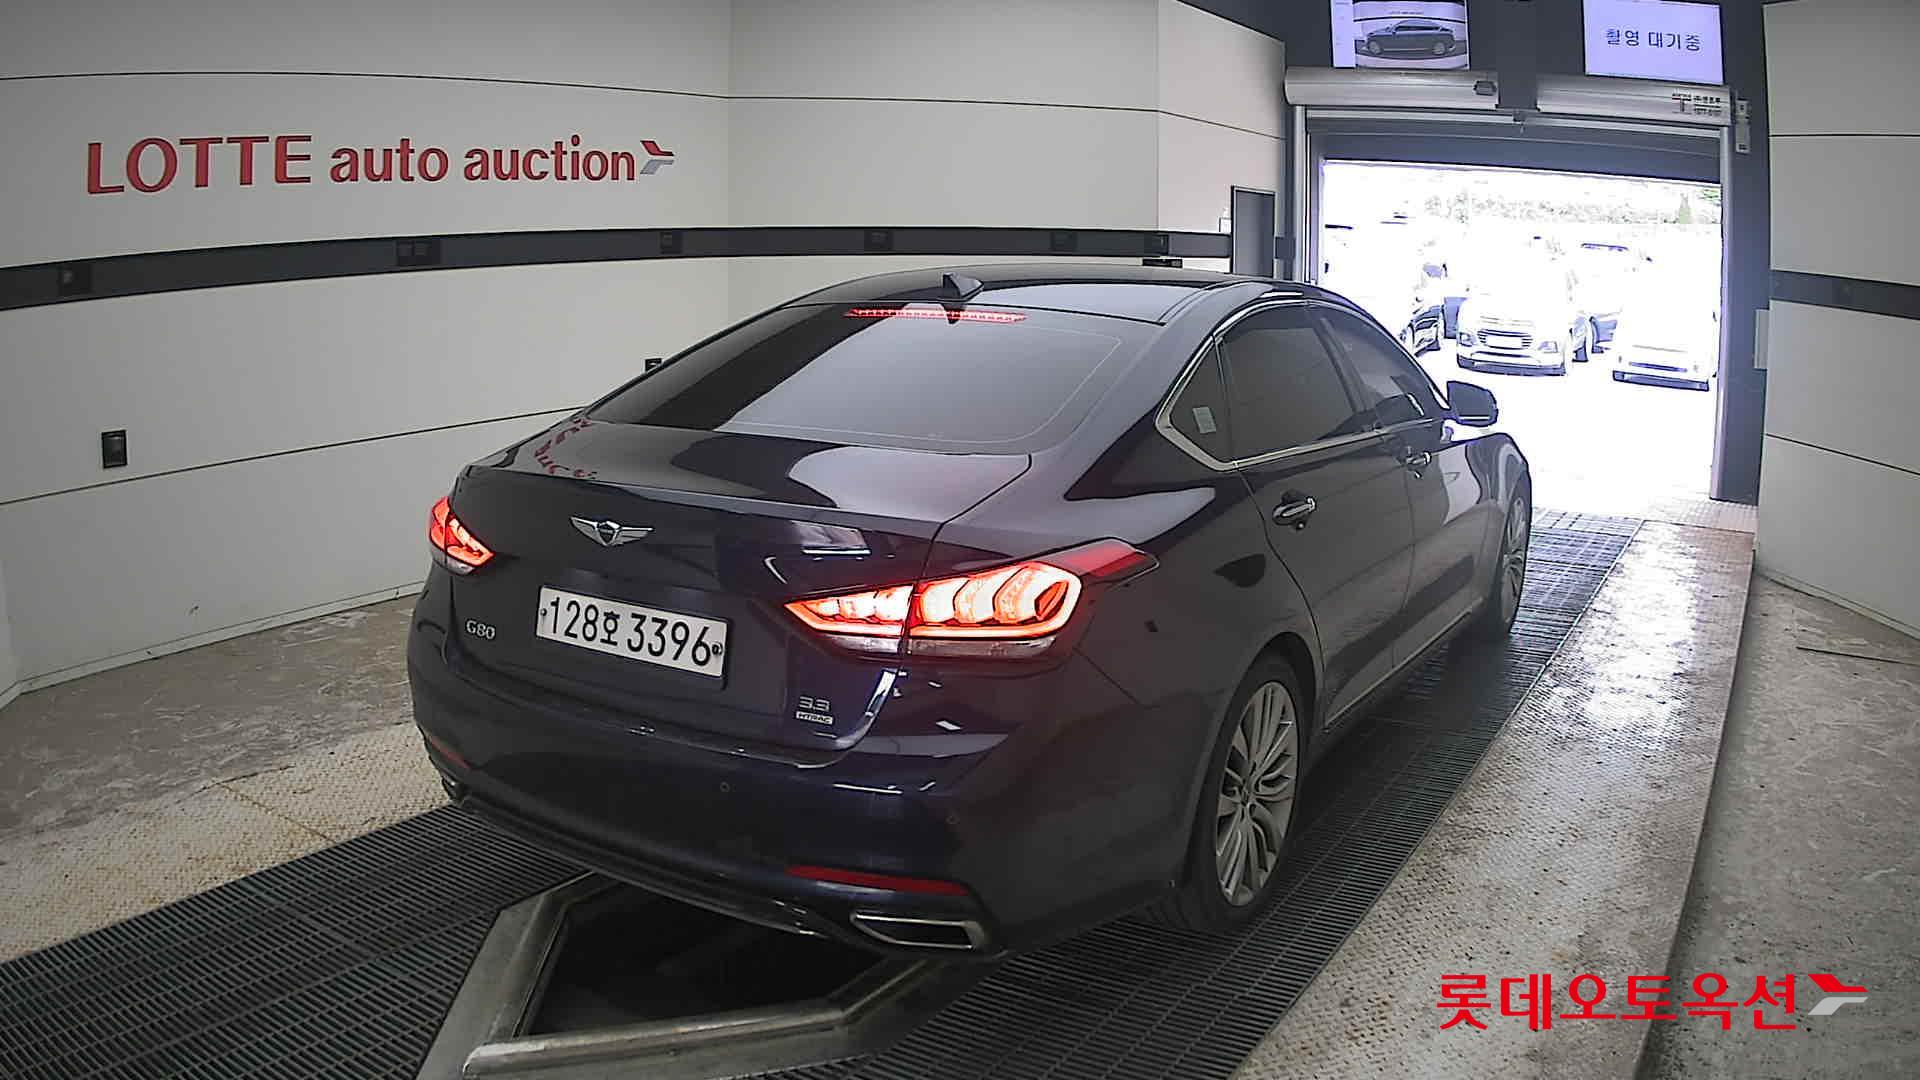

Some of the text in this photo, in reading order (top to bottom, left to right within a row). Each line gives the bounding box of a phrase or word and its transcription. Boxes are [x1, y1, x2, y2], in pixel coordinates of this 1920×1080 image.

[87, 134, 636, 194] LOTTE auto auction
[466, 620, 496, 640] G80
[626, 612, 712, 666] 3396
[799, 695, 830, 712] 3.3
